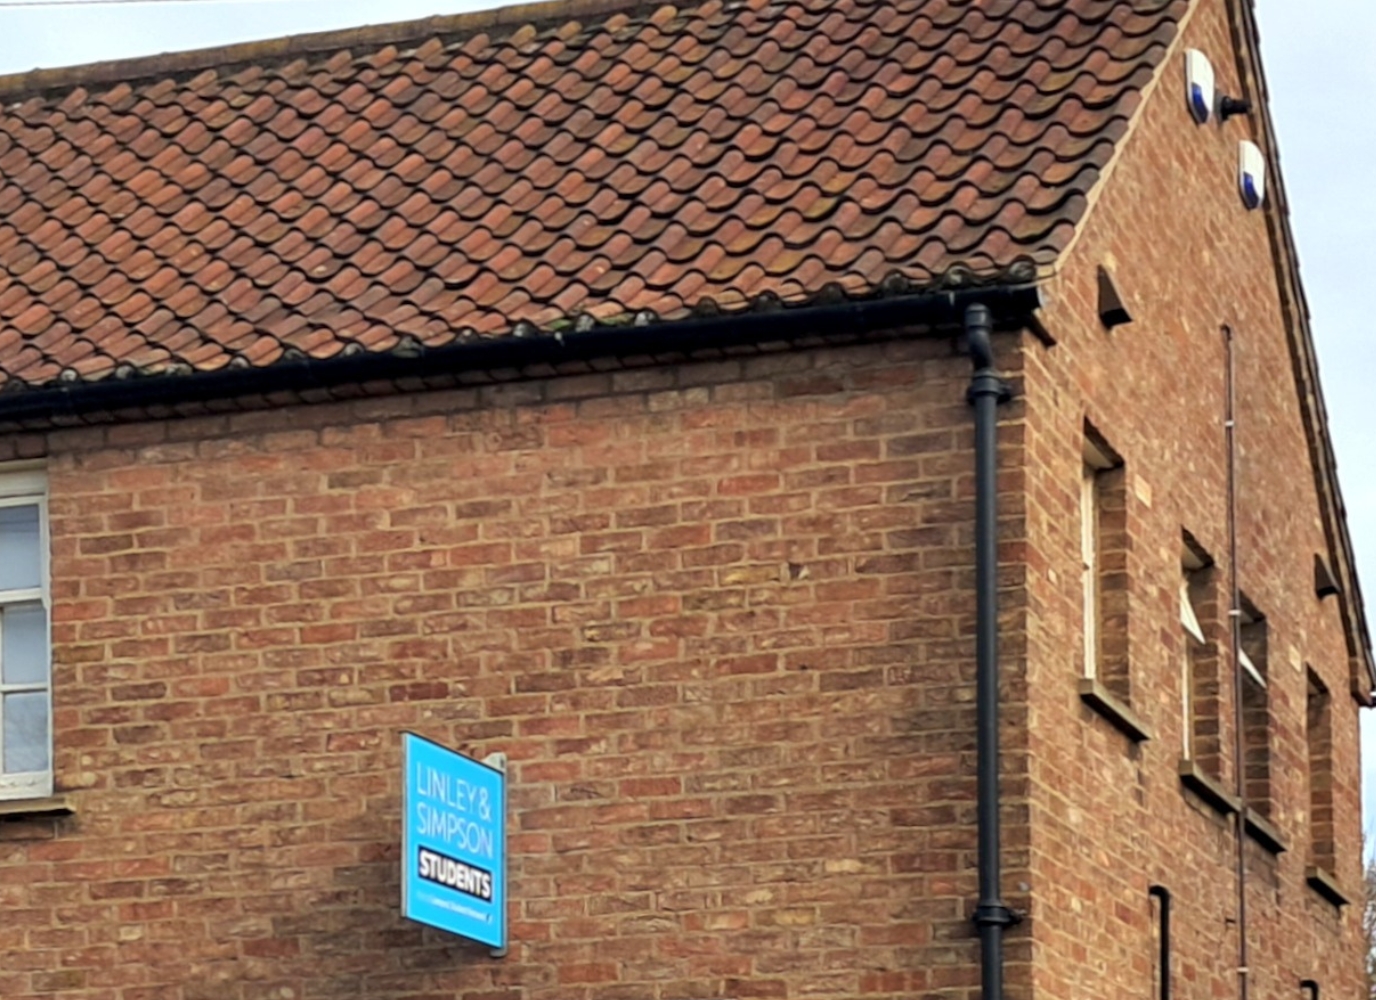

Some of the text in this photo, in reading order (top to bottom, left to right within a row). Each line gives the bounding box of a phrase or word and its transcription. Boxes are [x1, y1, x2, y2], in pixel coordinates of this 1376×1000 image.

[417, 761, 491, 822] LINLEY &
[417, 802, 493, 859] SIMPSON
[419, 850, 491, 898] STUDENTS
